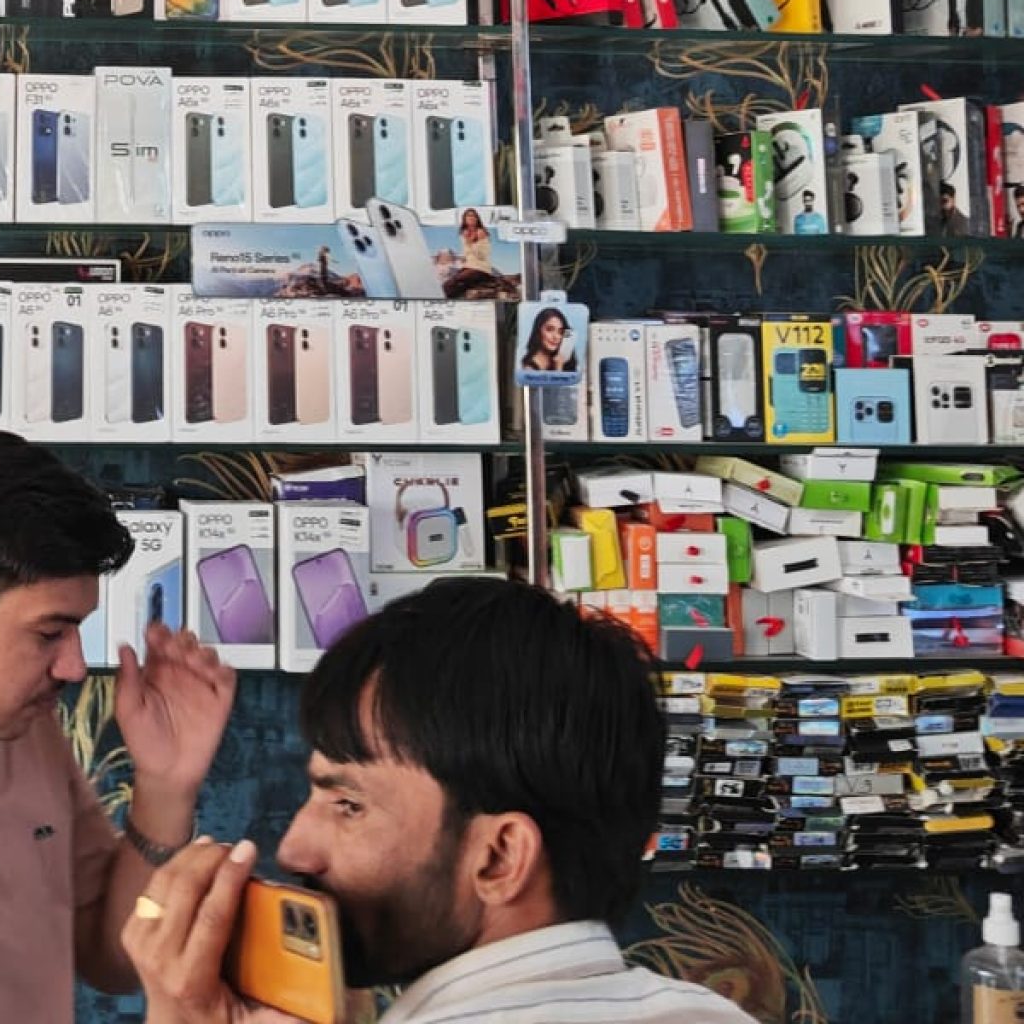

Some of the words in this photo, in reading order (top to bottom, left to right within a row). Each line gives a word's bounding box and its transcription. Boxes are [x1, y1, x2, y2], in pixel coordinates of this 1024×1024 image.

[104, 74, 164, 86] POVA
[255, 252, 290, 263] Series
[776, 326, 825, 344] V112
[198, 514, 232, 525] OPPO
[293, 517, 328, 529] OPPO
[128, 519, 173, 536] alaxy
[141, 538, 162, 552] 5G
